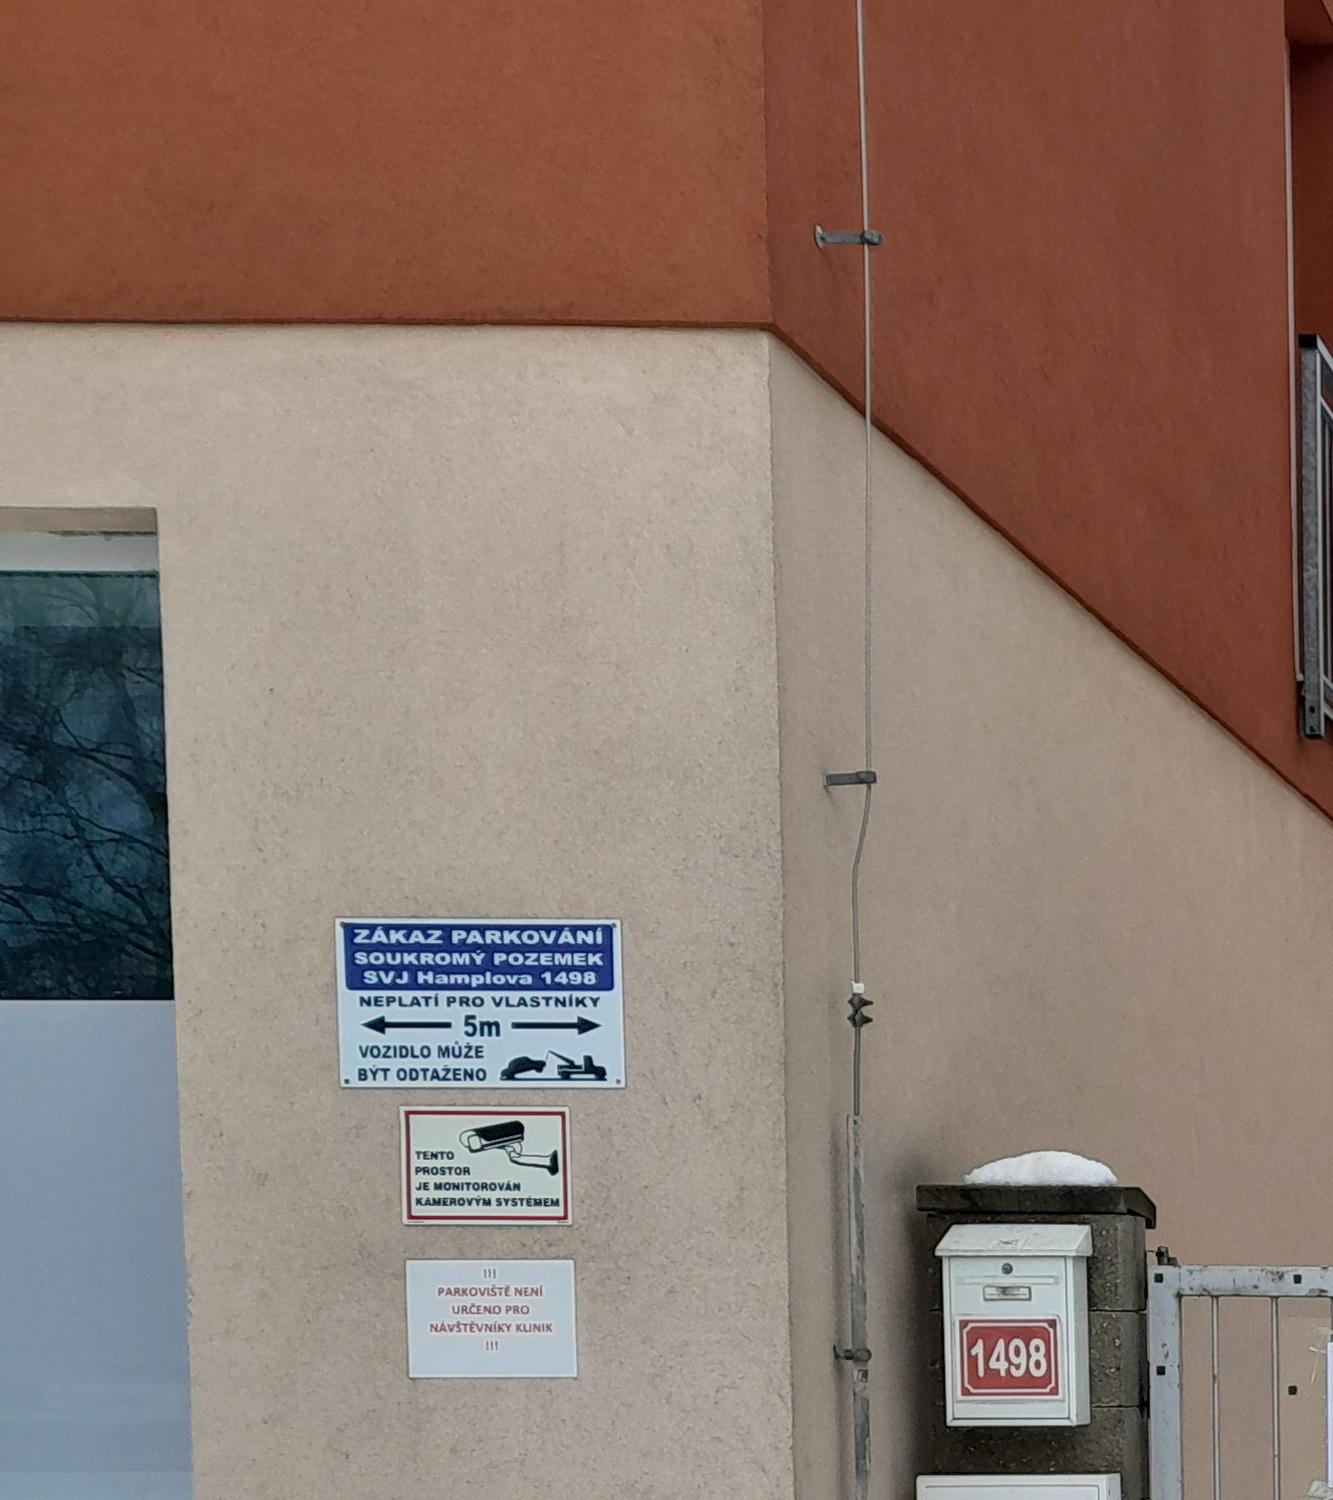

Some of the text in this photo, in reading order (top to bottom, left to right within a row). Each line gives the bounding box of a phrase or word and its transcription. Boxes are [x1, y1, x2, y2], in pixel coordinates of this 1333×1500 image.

[353, 926, 603, 945] ZÁKAZ PARKOVÁNÍ
[354, 949, 604, 966] SOUKROMÝ POZEMEK
[363, 970, 597, 988] SVJ Hamplova 1498
[359, 994, 601, 1008] NEPLATÍ PRO VLASTNÍKY
[463, 1014, 501, 1037] 5m
[358, 1040, 485, 1059] VOZIDLO MŮŽE
[357, 1064, 487, 1082] BÝT ODTAŽENO
[415, 1150, 455, 1161] TENTO
[415, 1166, 471, 1176] PROSTOR
[415, 1180, 521, 1192] JE MONITOROVÁN
[415, 1195, 561, 1208] KAMEROVÝM SYSTÉMEM
[437, 1284, 544, 1297] PARKOVIŠTĚ NENÍ
[451, 1302, 530, 1315] URČENO PRO
[429, 1320, 553, 1333] NÁVŠTĚVNÍKY KLINIK
[970, 1338, 1047, 1378] 1498
